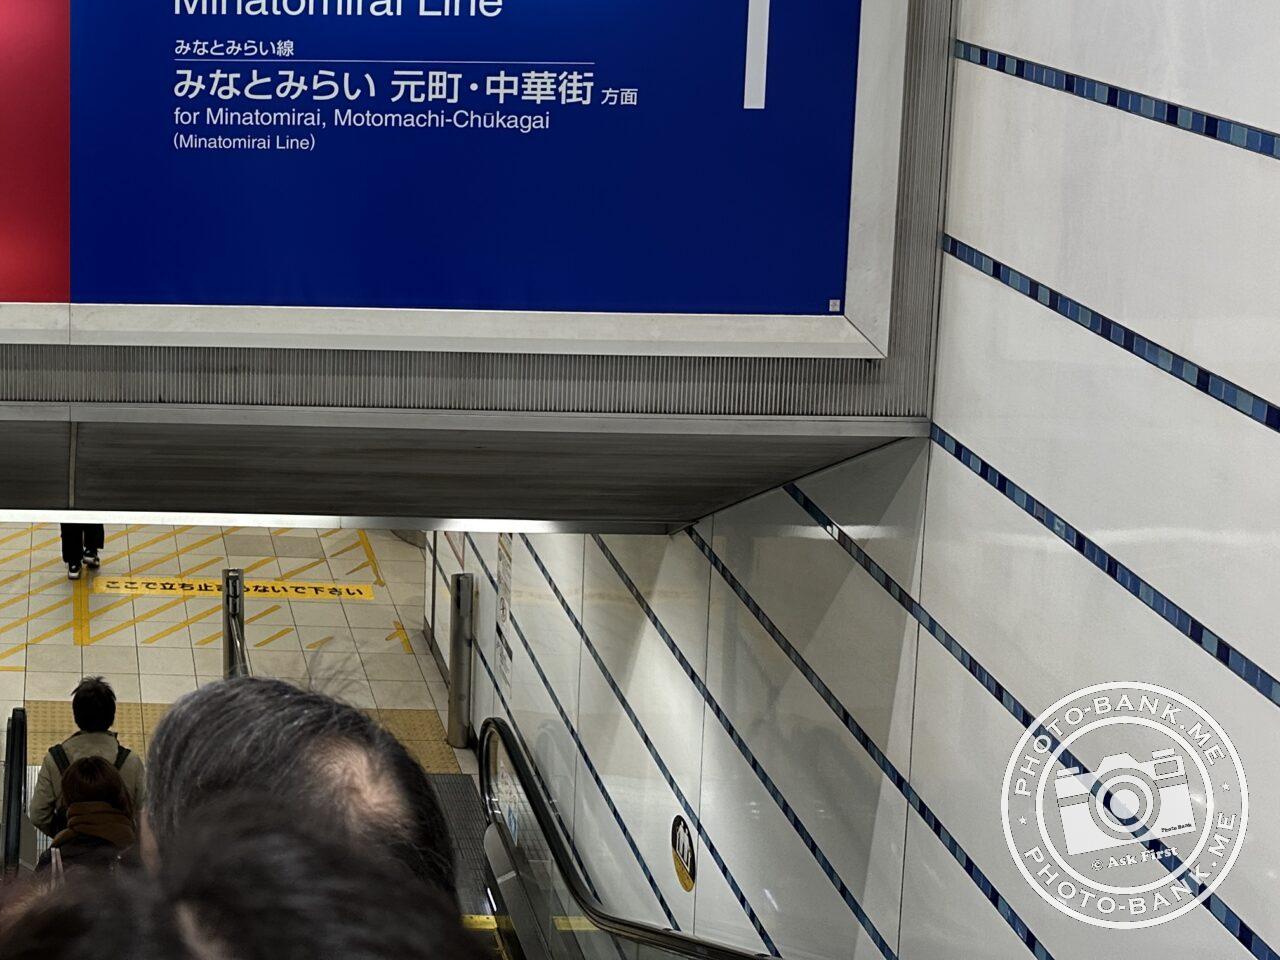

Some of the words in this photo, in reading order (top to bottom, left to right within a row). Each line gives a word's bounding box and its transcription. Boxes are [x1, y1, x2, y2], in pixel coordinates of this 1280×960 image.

[174, 39, 294, 57] みなとみらい線
[173, 69, 376, 101] みなとみらい
[390, 70, 595, 106] 元町・中華街
[601, 87, 639, 106] 方面
[173, 107, 201, 127] for
[206, 107, 327, 128] Minatomirai,
[334, 109, 551, 134] Motomachi-Chūkagai
[173, 131, 271, 151] (Minatomirai
[276, 132, 316, 151] Line)
